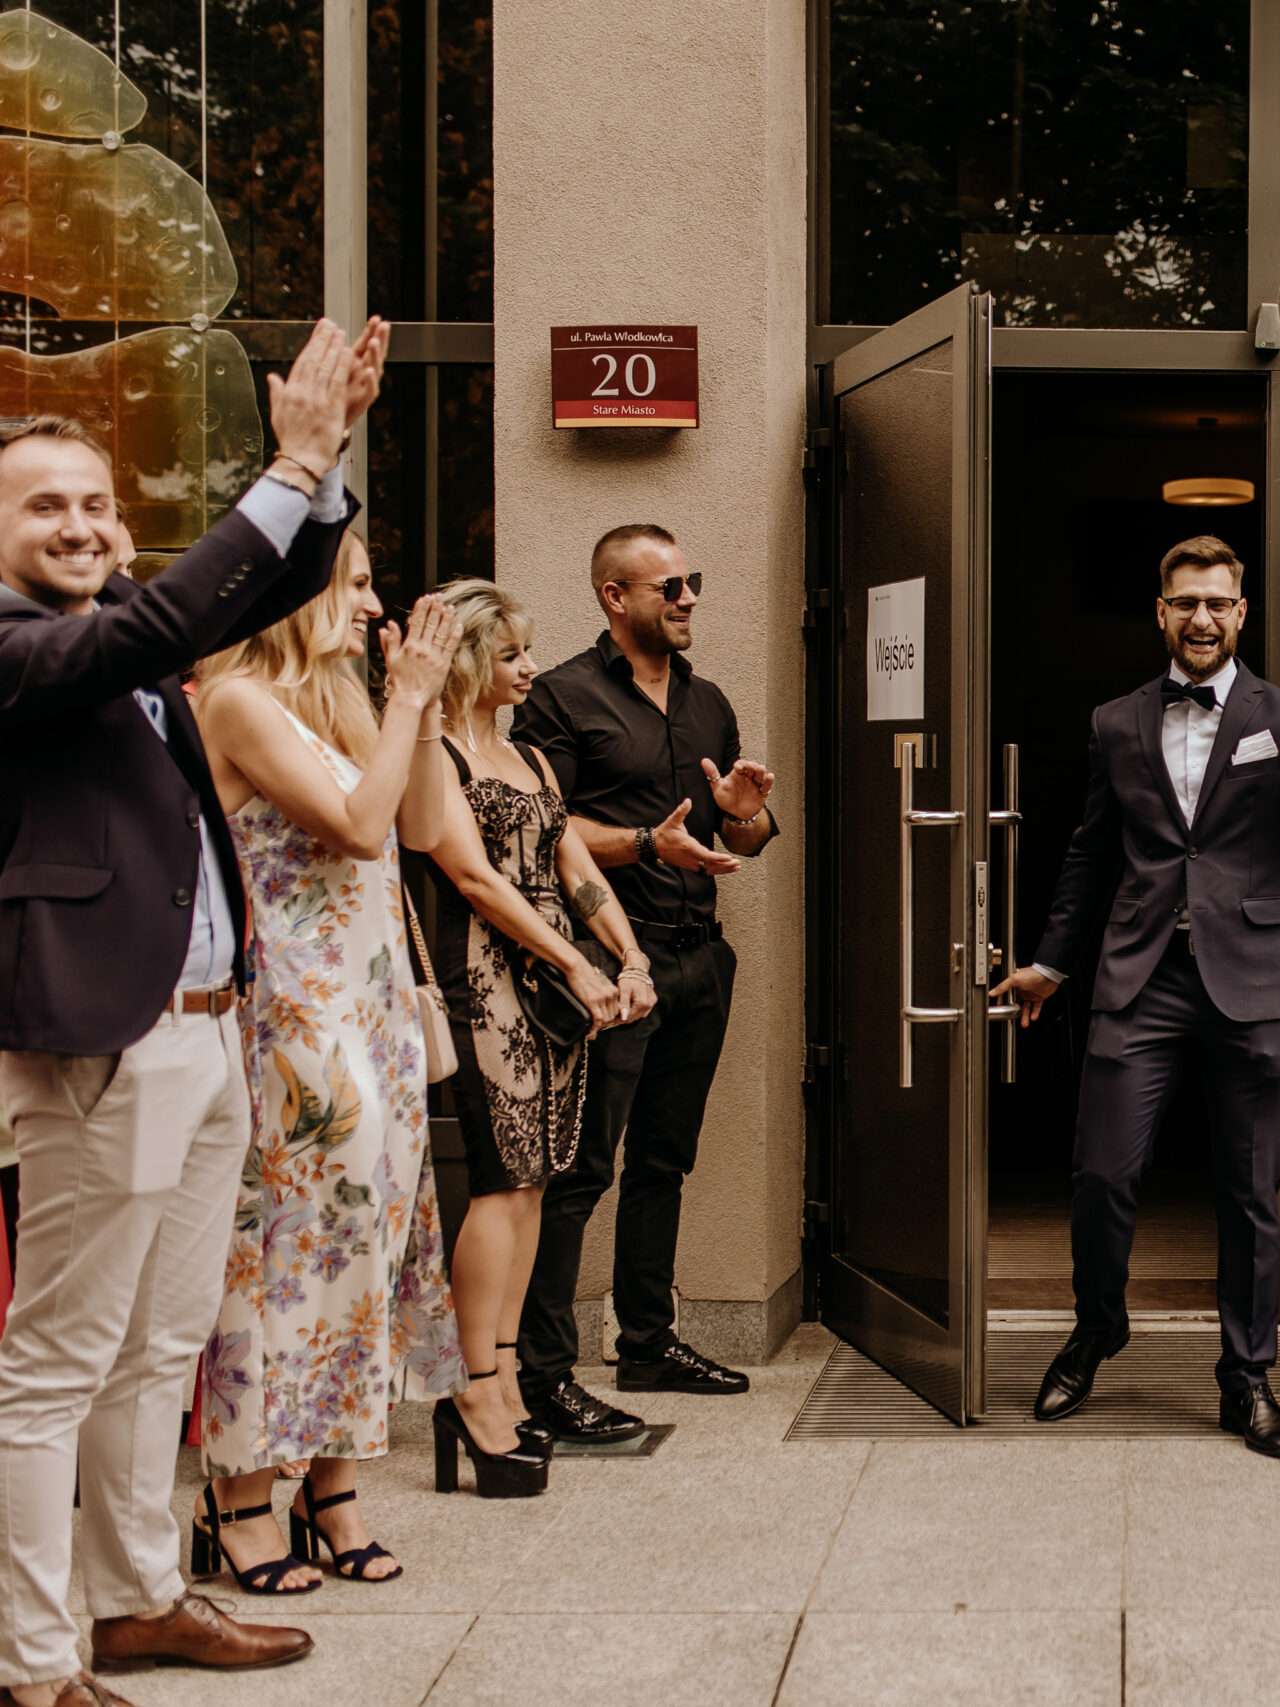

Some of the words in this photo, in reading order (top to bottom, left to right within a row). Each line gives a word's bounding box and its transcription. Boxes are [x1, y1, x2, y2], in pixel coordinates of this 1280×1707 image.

[570, 331, 582, 342] ul.
[614, 331, 674, 343] Włodkowica
[591, 353, 656, 397] 20
[593, 404, 618, 415] Stare
[620, 405, 656, 415] Miasto
[874, 634, 915, 681] Wejście
